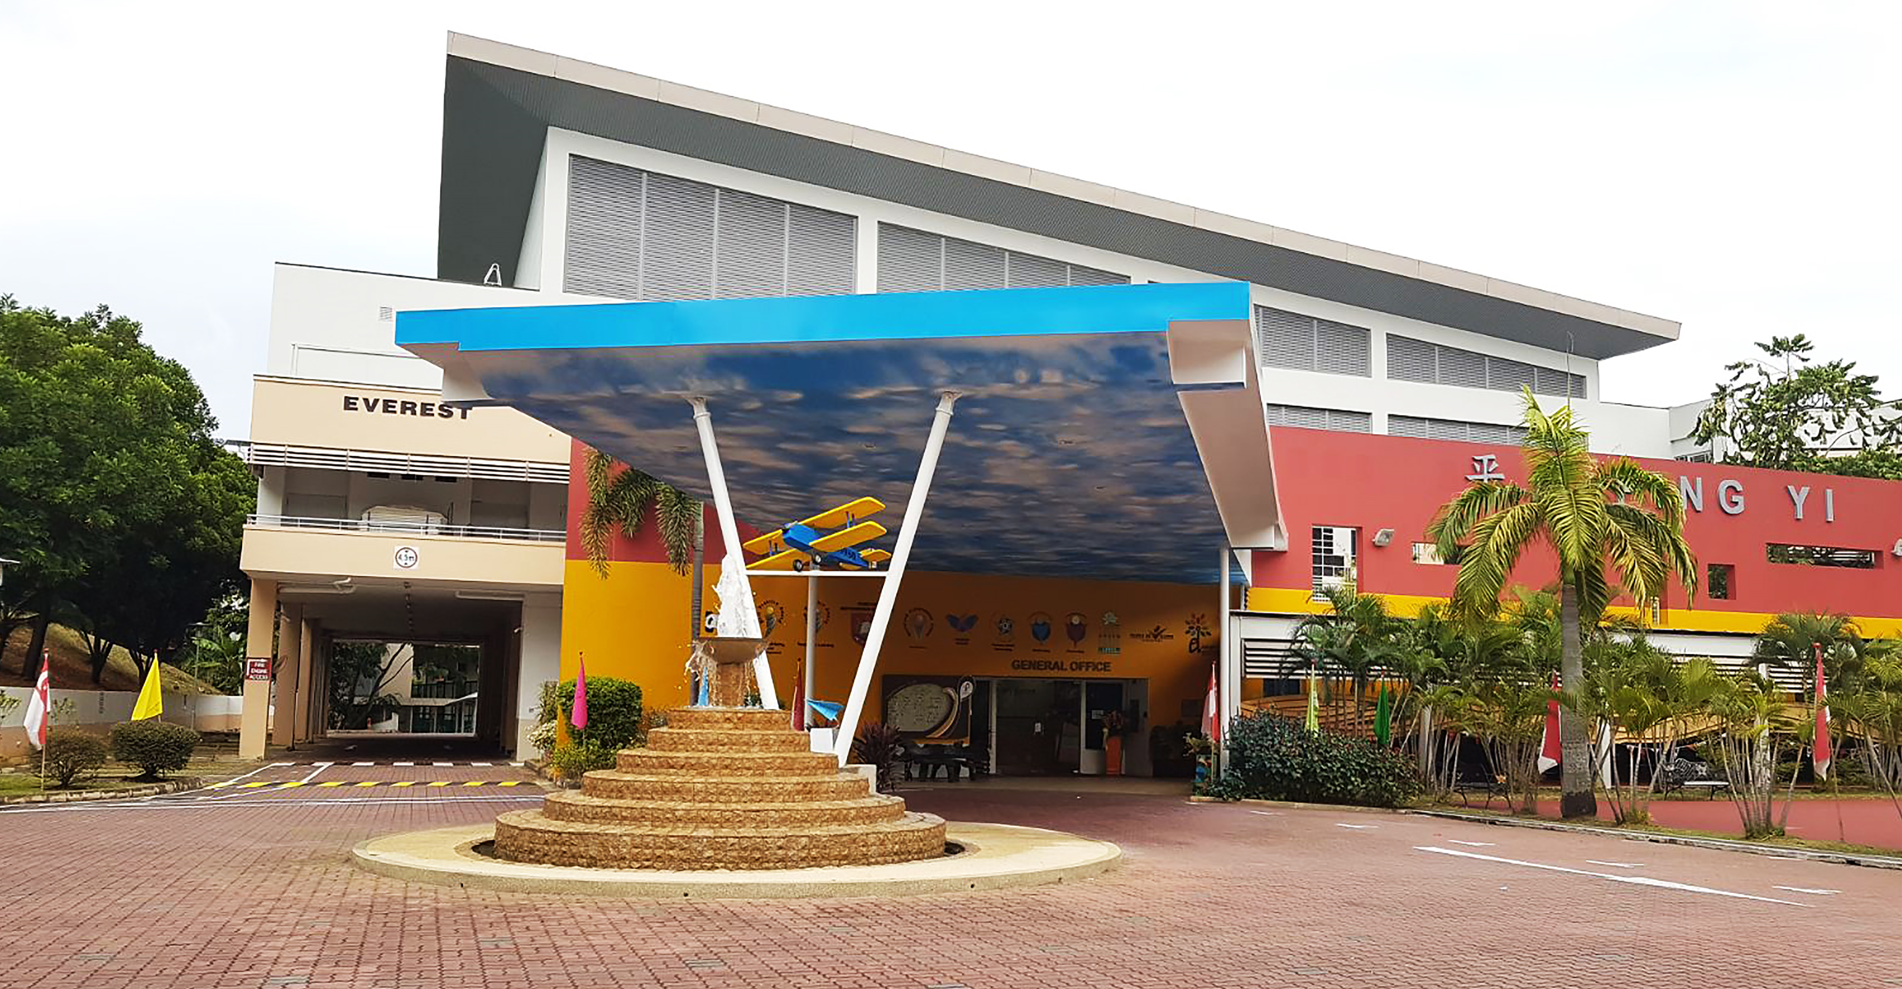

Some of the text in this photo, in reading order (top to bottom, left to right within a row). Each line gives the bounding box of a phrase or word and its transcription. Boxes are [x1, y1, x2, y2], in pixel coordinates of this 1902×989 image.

[343, 395, 472, 420] EVEREST
[1786, 485, 1834, 522] YI
[1012, 659, 1112, 672] GENERAL OFFICE
